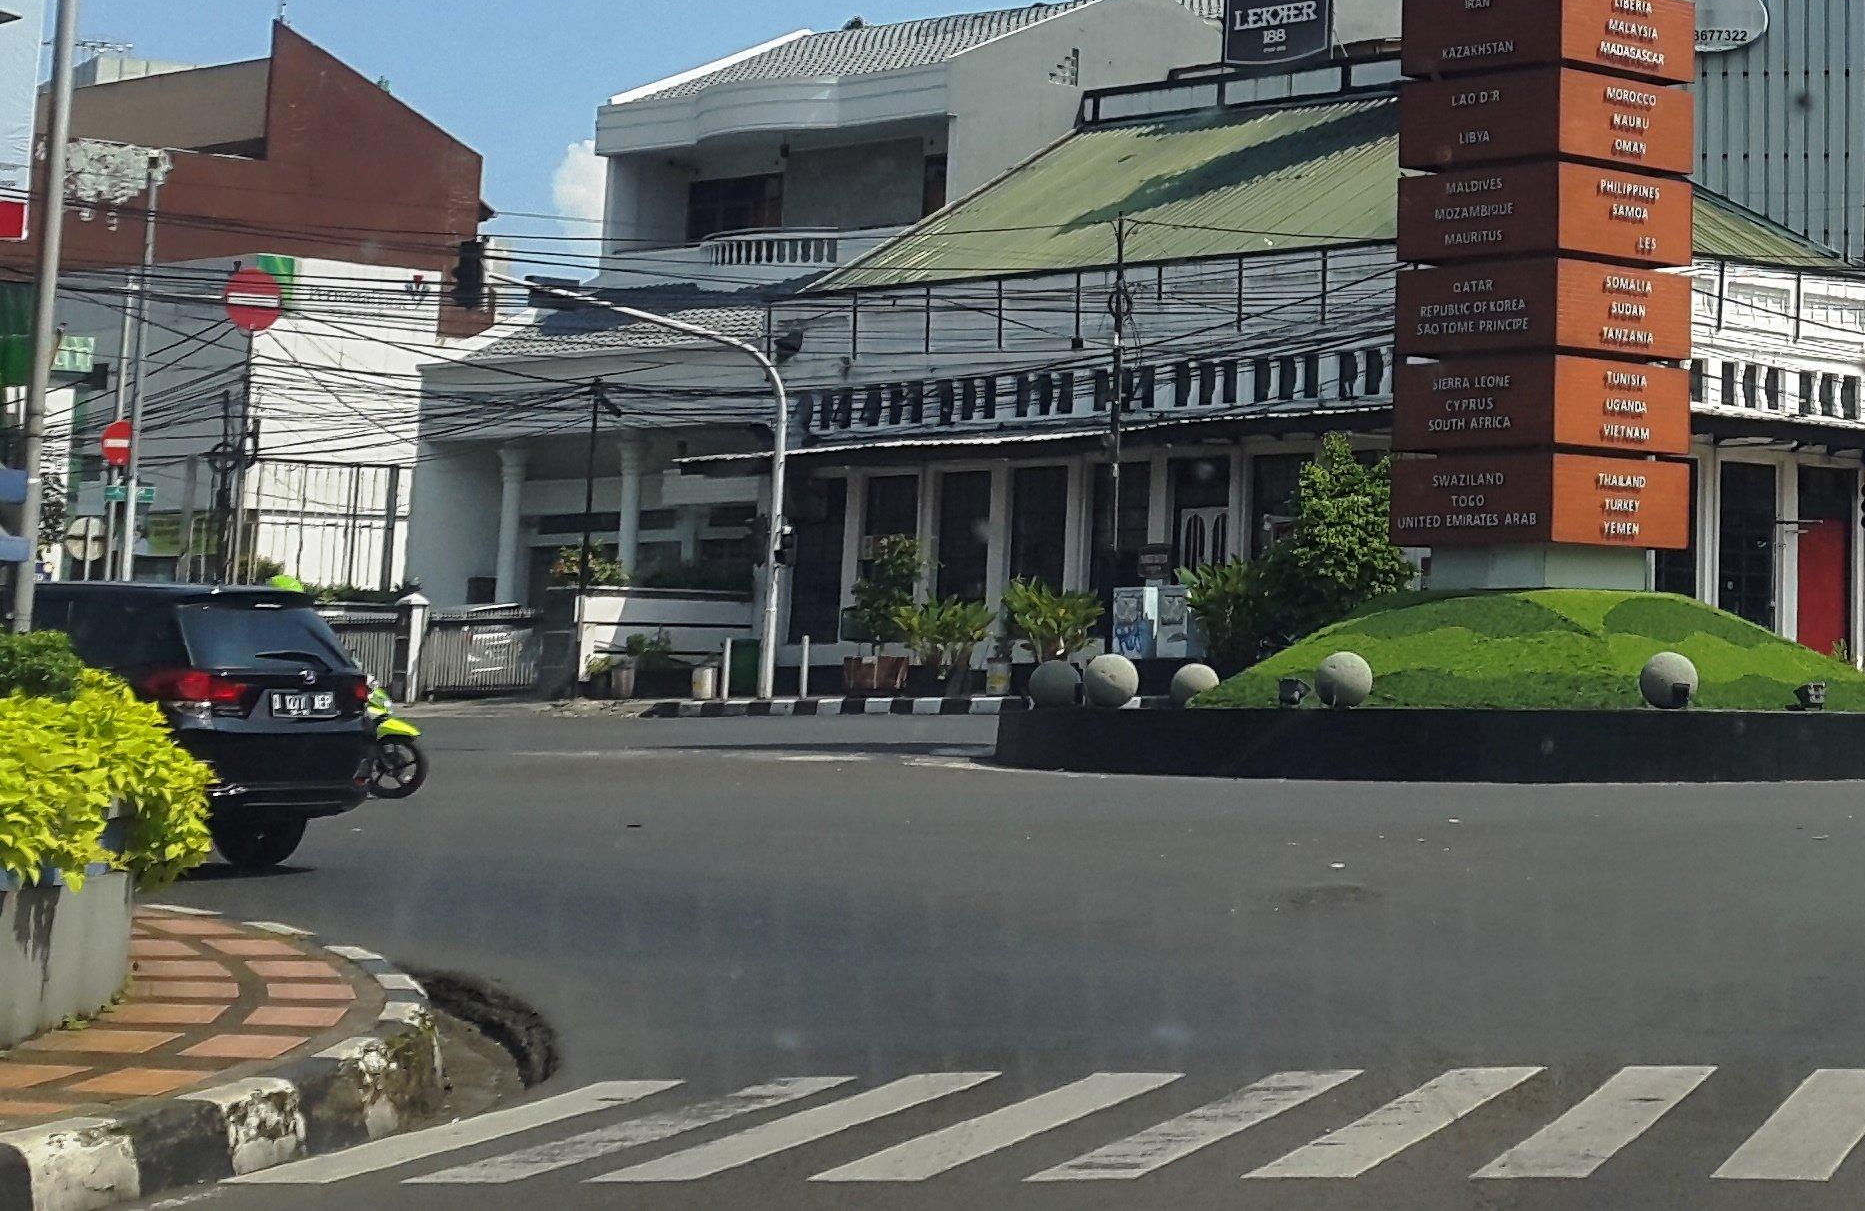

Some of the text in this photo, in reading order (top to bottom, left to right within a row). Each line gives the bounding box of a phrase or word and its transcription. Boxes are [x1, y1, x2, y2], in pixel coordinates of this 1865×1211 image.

[1234, 1, 1318, 30] LEKKER
[1263, 29, 1286, 44] 188
[1608, 18, 1658, 40] MALAYSIA
[1442, 40, 1514, 59] KAZAKHSTAN
[1600, 40, 1665, 65] MADAGASCAR
[1451, 92, 1476, 107] LAO
[1606, 86, 1657, 106] MOROCCO
[1613, 113, 1650, 130] NAURU
[1459, 130, 1490, 145] LIBYA
[1615, 137, 1647, 155] OMAN
[1445, 177, 1503, 195] MALDIVES
[1600, 178, 1660, 200] PHILIPPINES
[1434, 202, 1514, 220] MOZAMBIQUE
[1612, 204, 1649, 220] SAMOA
[1453, 279, 1493, 293] QATAR
[1605, 276, 1653, 293] SOMALIA
[1420, 298, 1526, 318] REPUBLIC OF KOREA
[1611, 301, 1646, 318] SUDAN
[1417, 317, 1529, 335] SAO TOME PRINCIPE
[1602, 326, 1654, 344] TANZANIA
[1432, 375, 1511, 390] SIERRA LEONE
[1606, 370, 1648, 387] TUNISIA
[1445, 398, 1494, 412] CYPRUS
[1606, 398, 1648, 414] UGANDA
[1428, 416, 1511, 431] SOUTH AFRICA
[1603, 423, 1650, 440] VIETNAM
[1432, 473, 1504, 488] SWAZILAND
[1598, 472, 1646, 488] THAILAND
[1451, 494, 1485, 507] TOGO
[1604, 498, 1640, 513] TURKEY
[1397, 512, 1537, 529] UNITED EMIRATES ARAB
[1603, 520, 1640, 535] YEMEN
